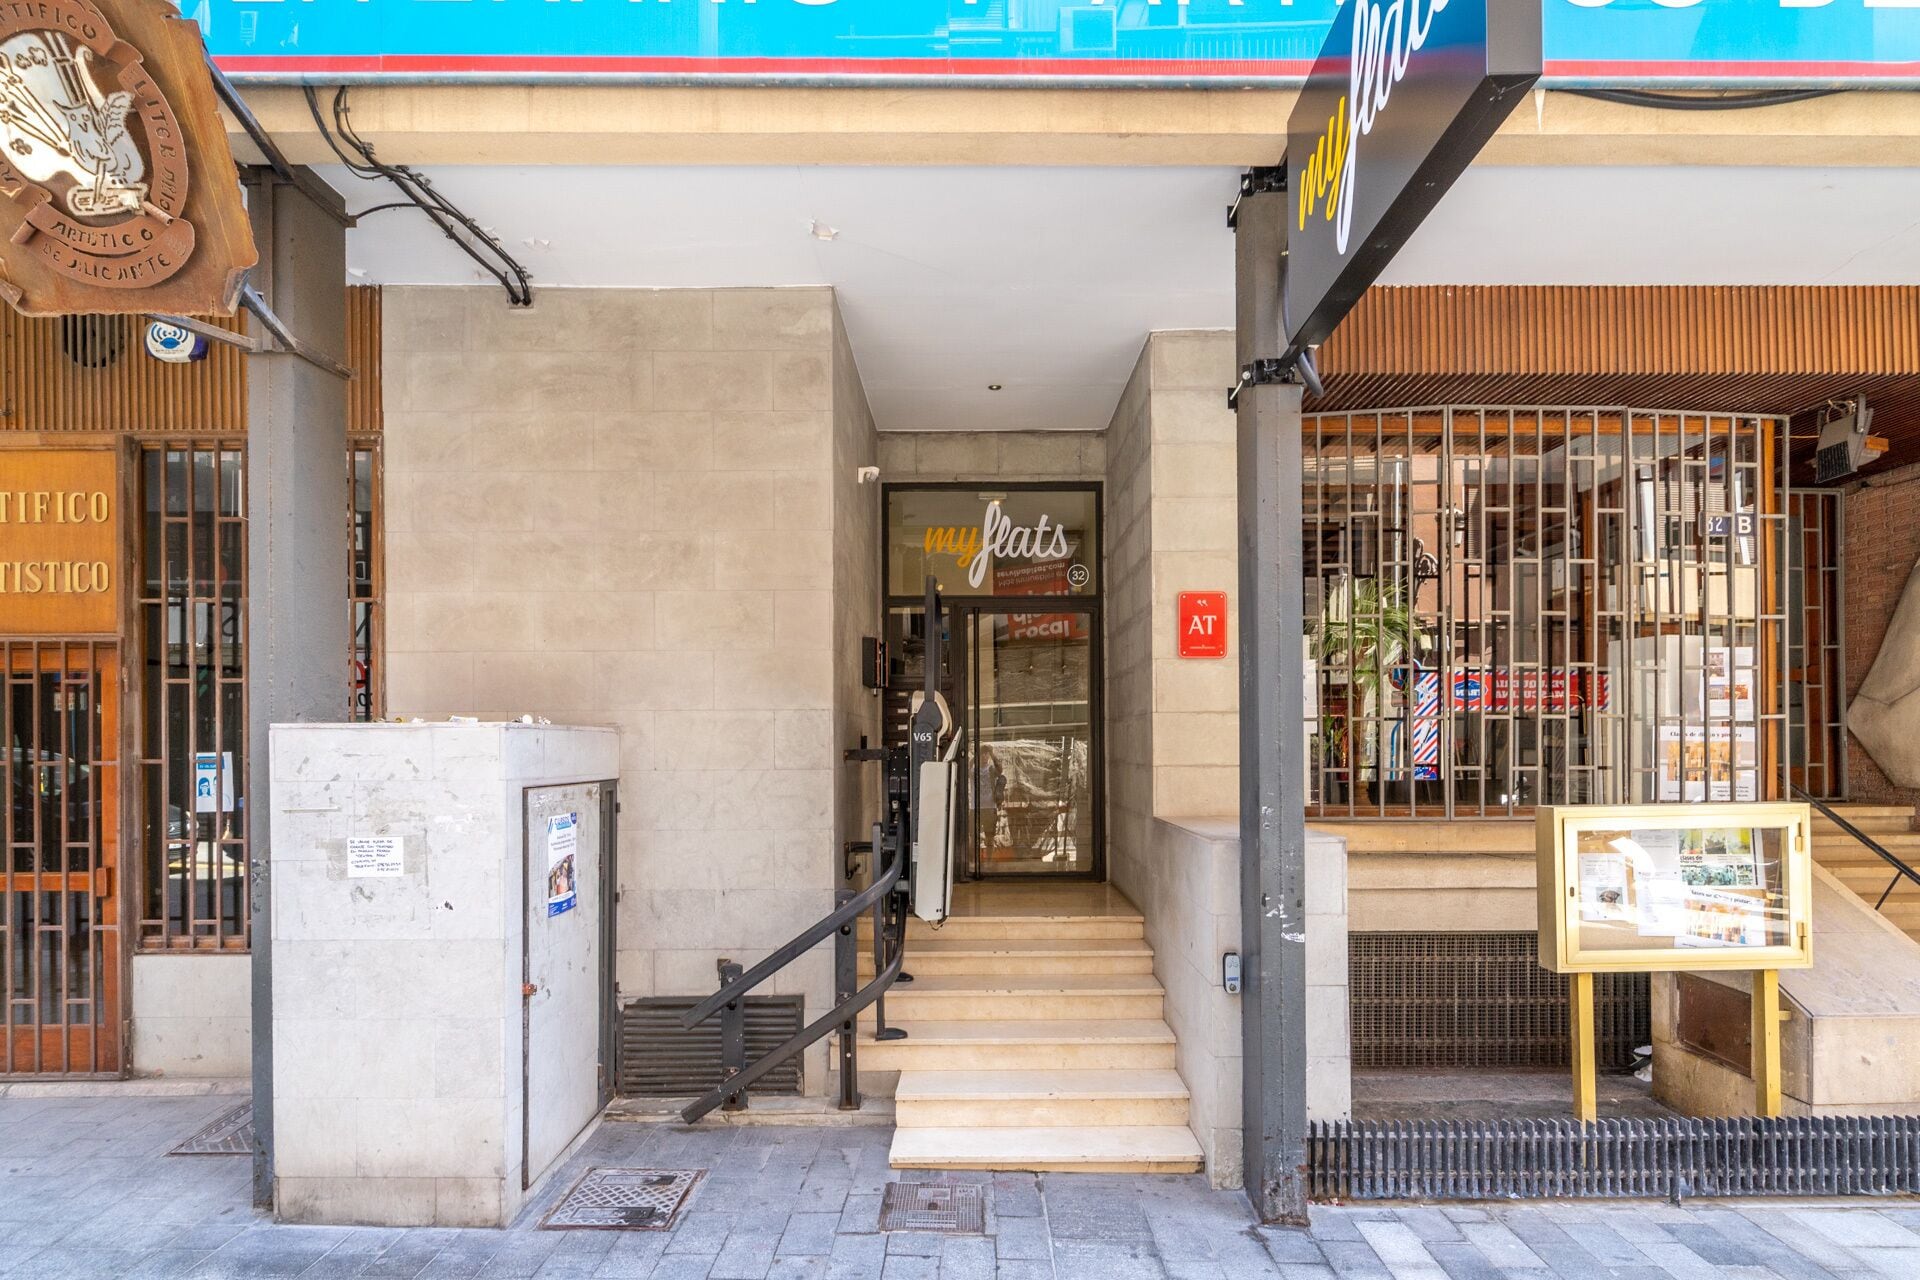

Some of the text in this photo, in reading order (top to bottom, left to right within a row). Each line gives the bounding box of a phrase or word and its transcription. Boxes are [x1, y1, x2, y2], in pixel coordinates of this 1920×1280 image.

[50, 220, 154, 248] ARTISTICO
[66, 253, 171, 281] ALICANTE
[1738, 516, 1752, 534] B
[1071, 570, 1085, 581] 32
[1188, 615, 1217, 635] AT
[913, 732, 932, 742] V65
